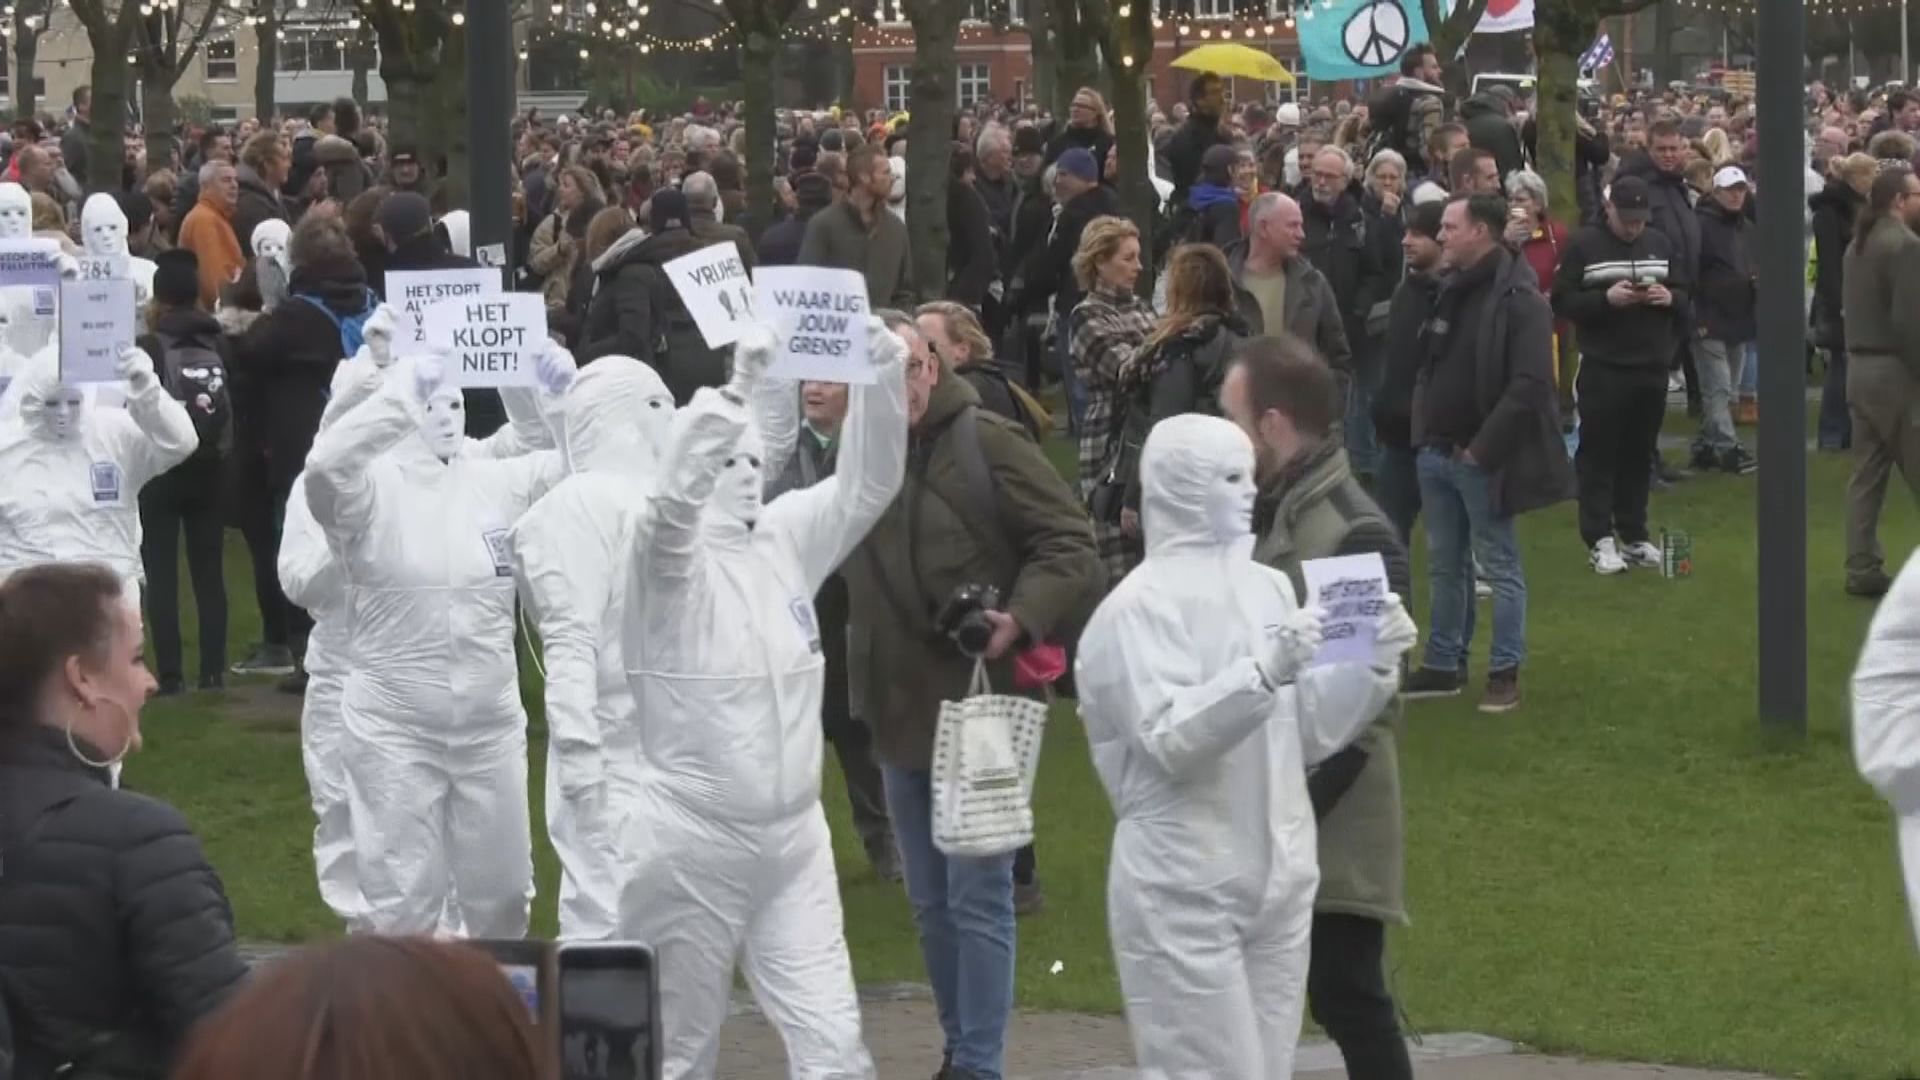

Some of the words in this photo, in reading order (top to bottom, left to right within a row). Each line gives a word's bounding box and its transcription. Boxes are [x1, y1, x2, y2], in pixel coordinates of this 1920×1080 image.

[405, 285, 431, 297] HET
[436, 283, 481, 297] STOPT
[773, 290, 831, 309] WAAR
[466, 304, 510, 322] HET
[796, 314, 849, 334] JOUW
[453, 328, 526, 347] KLOPT
[788, 336, 850, 356] GRENS?
[462, 352, 518, 371] NIET!
